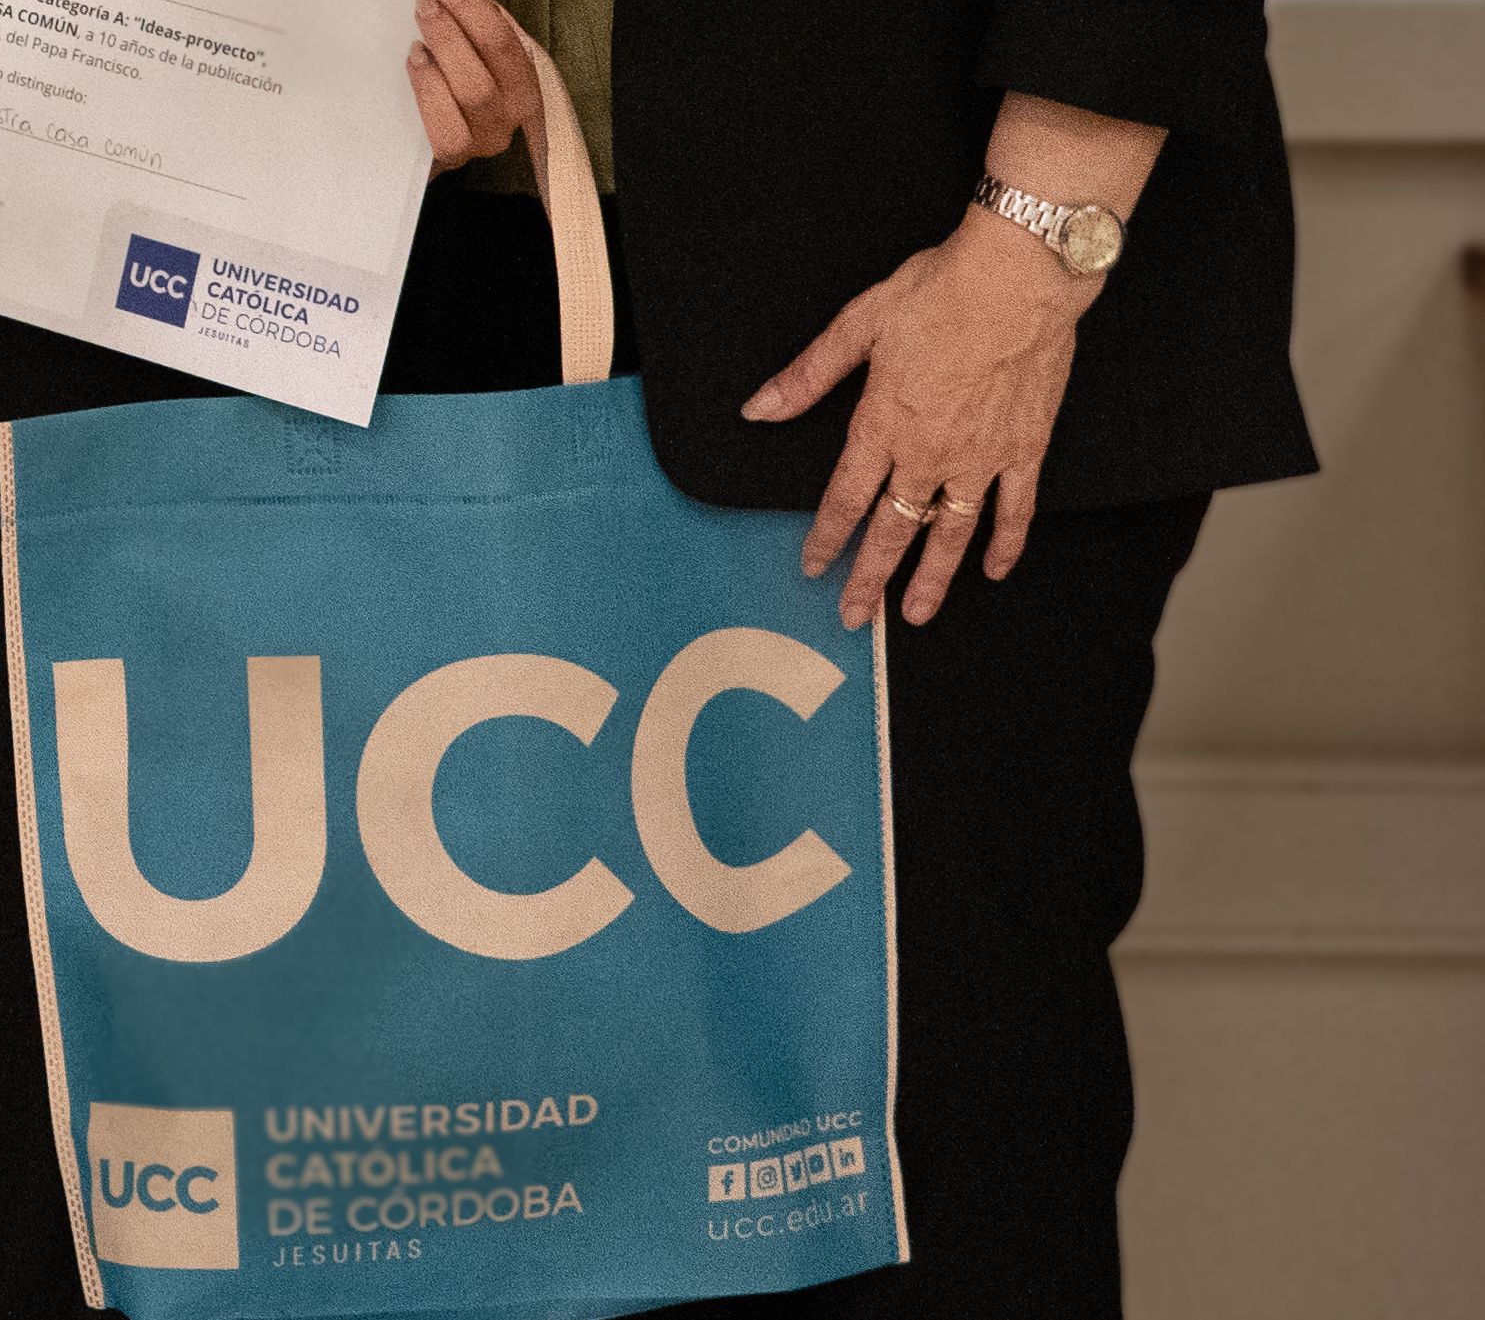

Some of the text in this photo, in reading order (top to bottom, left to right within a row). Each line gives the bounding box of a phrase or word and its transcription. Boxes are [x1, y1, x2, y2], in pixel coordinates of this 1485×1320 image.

[129, 262, 188, 299] UCC
[207, 281, 309, 325] CATÓLICA
[212, 259, 360, 314] UNIVERSIDAD
[198, 327, 250, 349] JESUITAS
[200, 302, 341, 358] DE CÓRDOBA
[53, 627, 852, 964] UCC
[265, 1094, 599, 1142] UNIVERSIDAD
[707, 1110, 862, 1155] COMUNIDAD UCC
[98, 1158, 220, 1215] UCC
[265, 1145, 503, 1189] CATÓLICA
[268, 1182, 584, 1237] DE CÓRDOBA
[707, 1188, 869, 1241] ucc.edu.ar
[272, 1238, 422, 1267] JESUITAS
